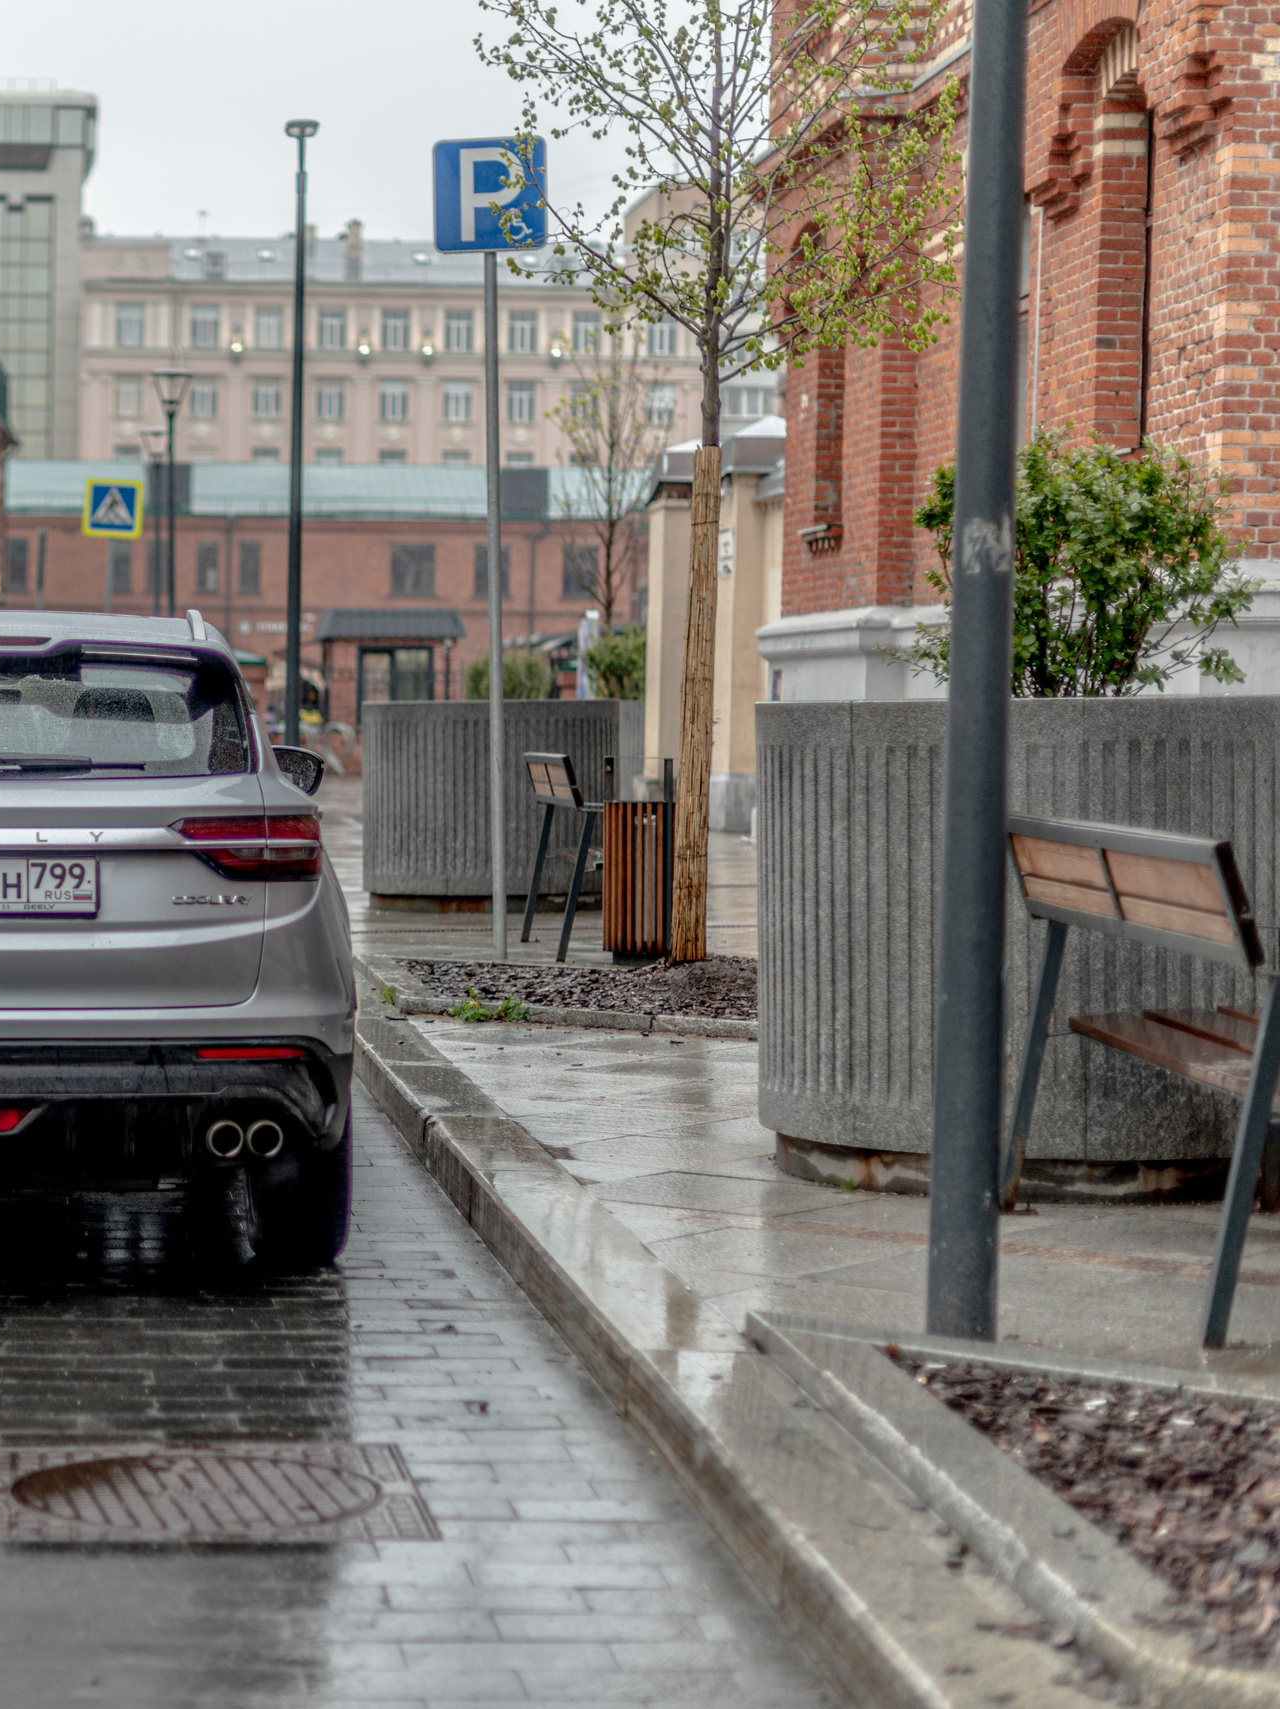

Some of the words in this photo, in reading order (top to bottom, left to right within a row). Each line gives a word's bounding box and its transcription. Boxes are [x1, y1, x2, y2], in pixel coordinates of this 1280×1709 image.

[459, 147, 525, 242] P
[30, 862, 86, 890] 799
[44, 890, 72, 901] RUS
